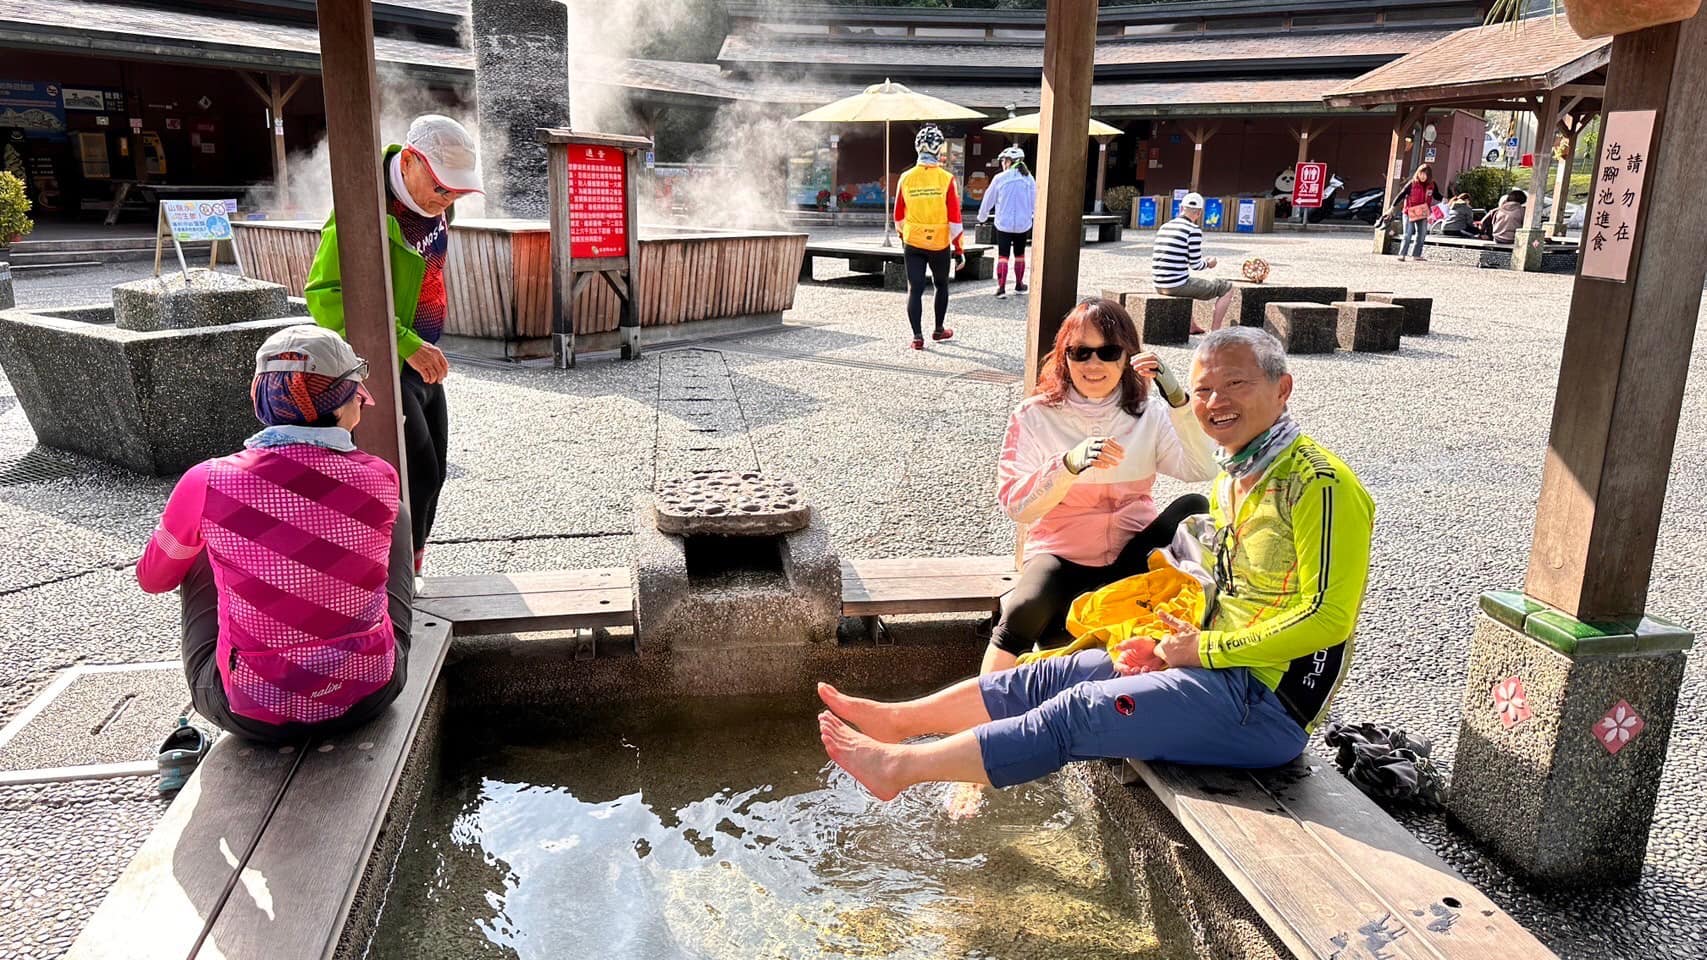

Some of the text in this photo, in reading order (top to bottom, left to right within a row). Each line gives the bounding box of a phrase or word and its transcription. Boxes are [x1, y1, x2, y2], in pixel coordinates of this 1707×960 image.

[1591, 142, 1621, 252] 泡腳池進食
[1614, 154, 1643, 242] 請勿在
[416, 221, 445, 253] RMOSA
[1226, 631, 1262, 650] Family
[1302, 647, 1329, 689] OPLE
[310, 679, 345, 698] nalini
